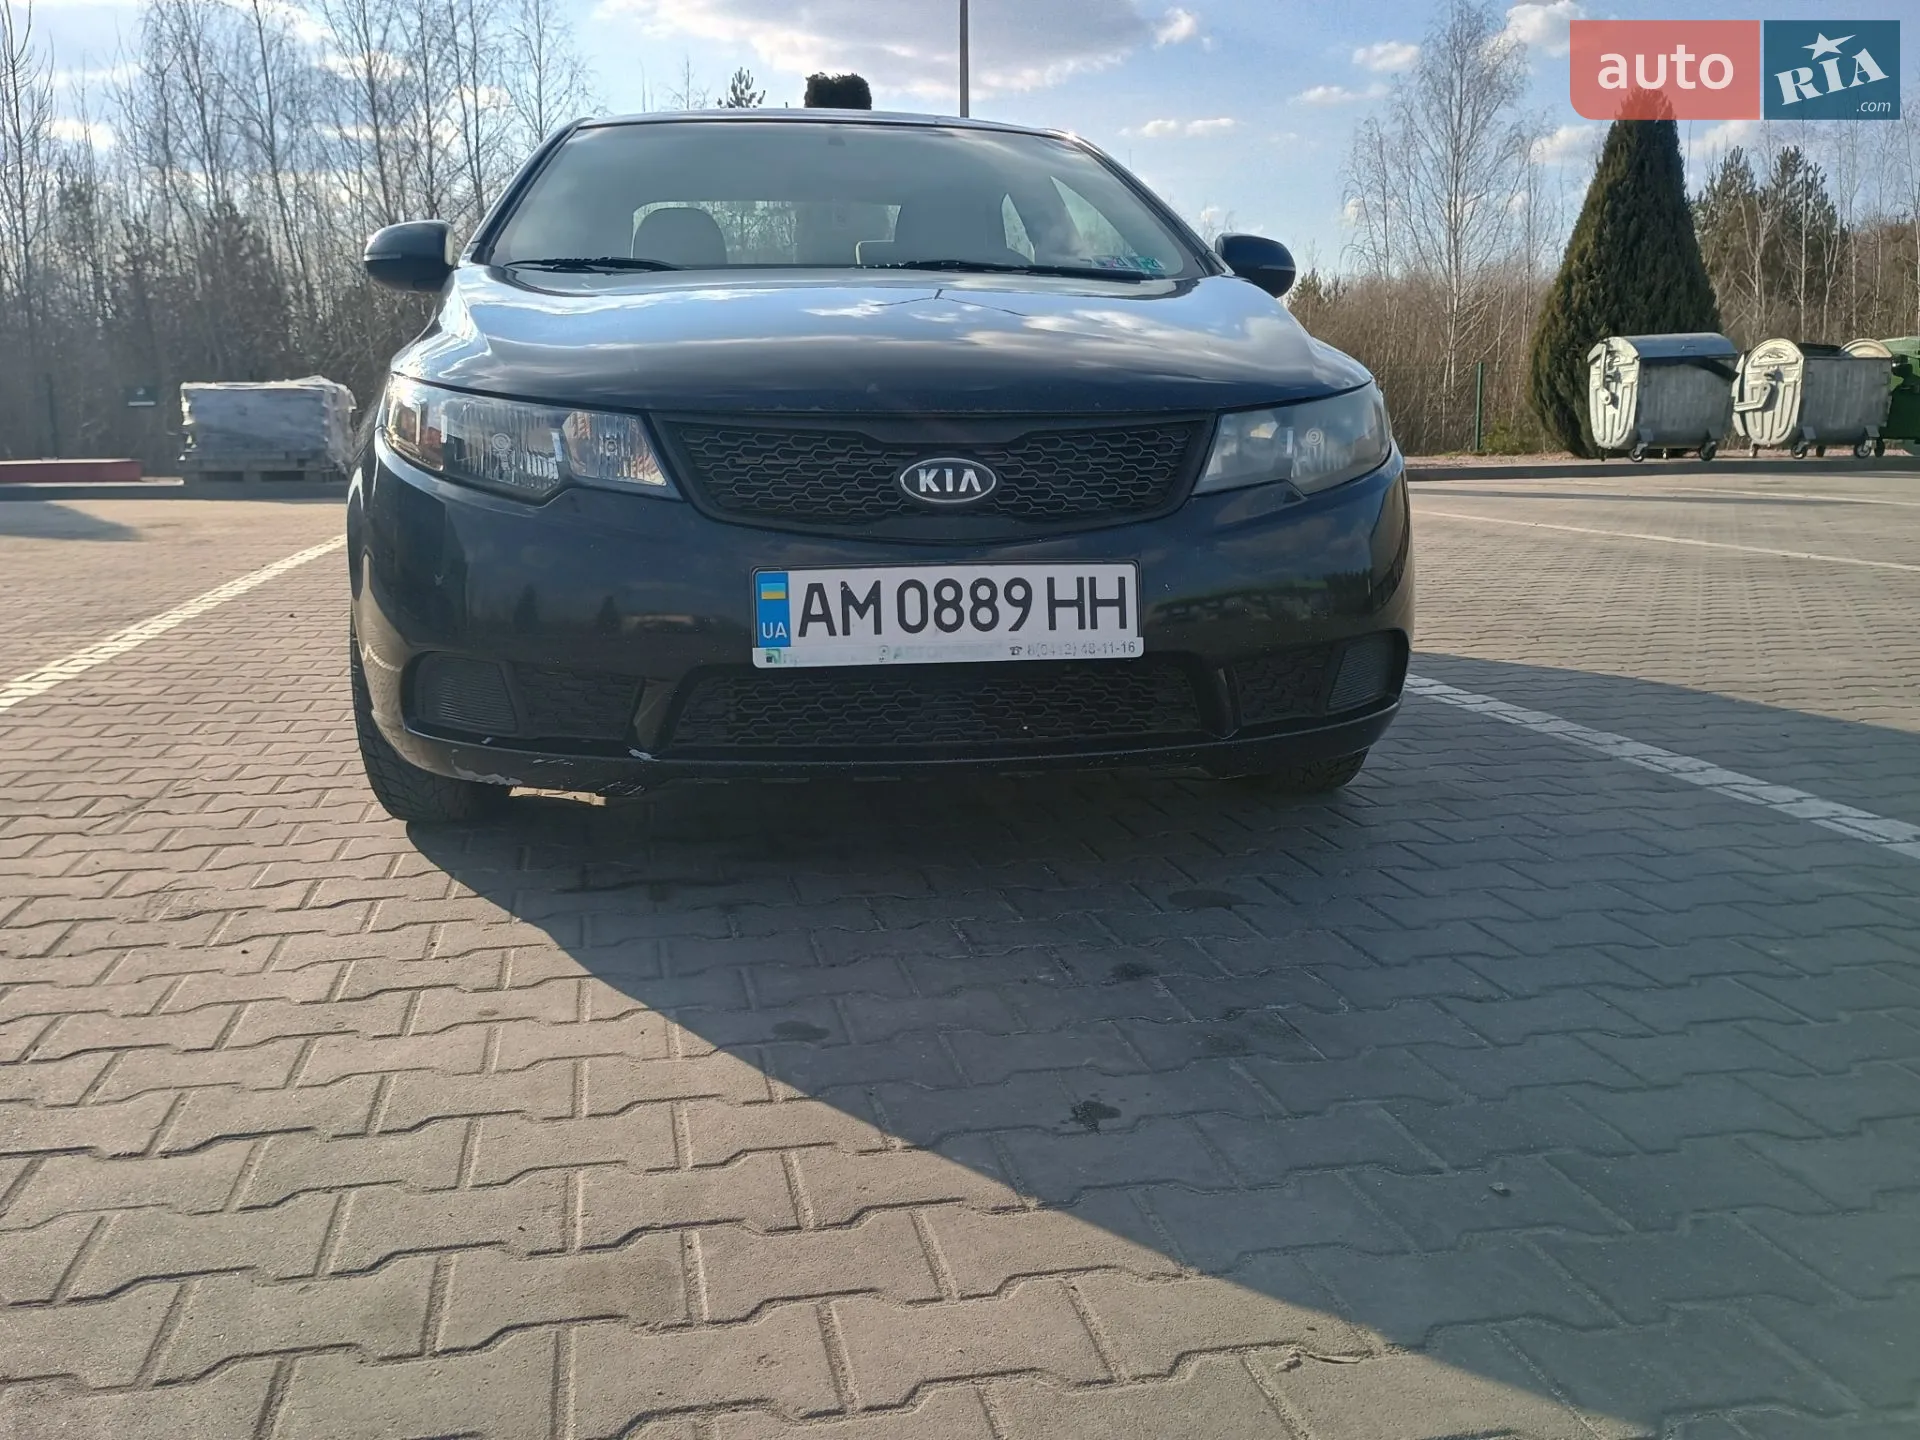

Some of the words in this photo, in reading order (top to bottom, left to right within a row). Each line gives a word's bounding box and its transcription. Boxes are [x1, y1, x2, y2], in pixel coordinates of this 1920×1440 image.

[917, 468, 982, 492] KIA
[797, 579, 883, 638] AM
[896, 576, 1033, 634] 0889
[1046, 575, 1127, 631] HH
[762, 621, 788, 639] UA
